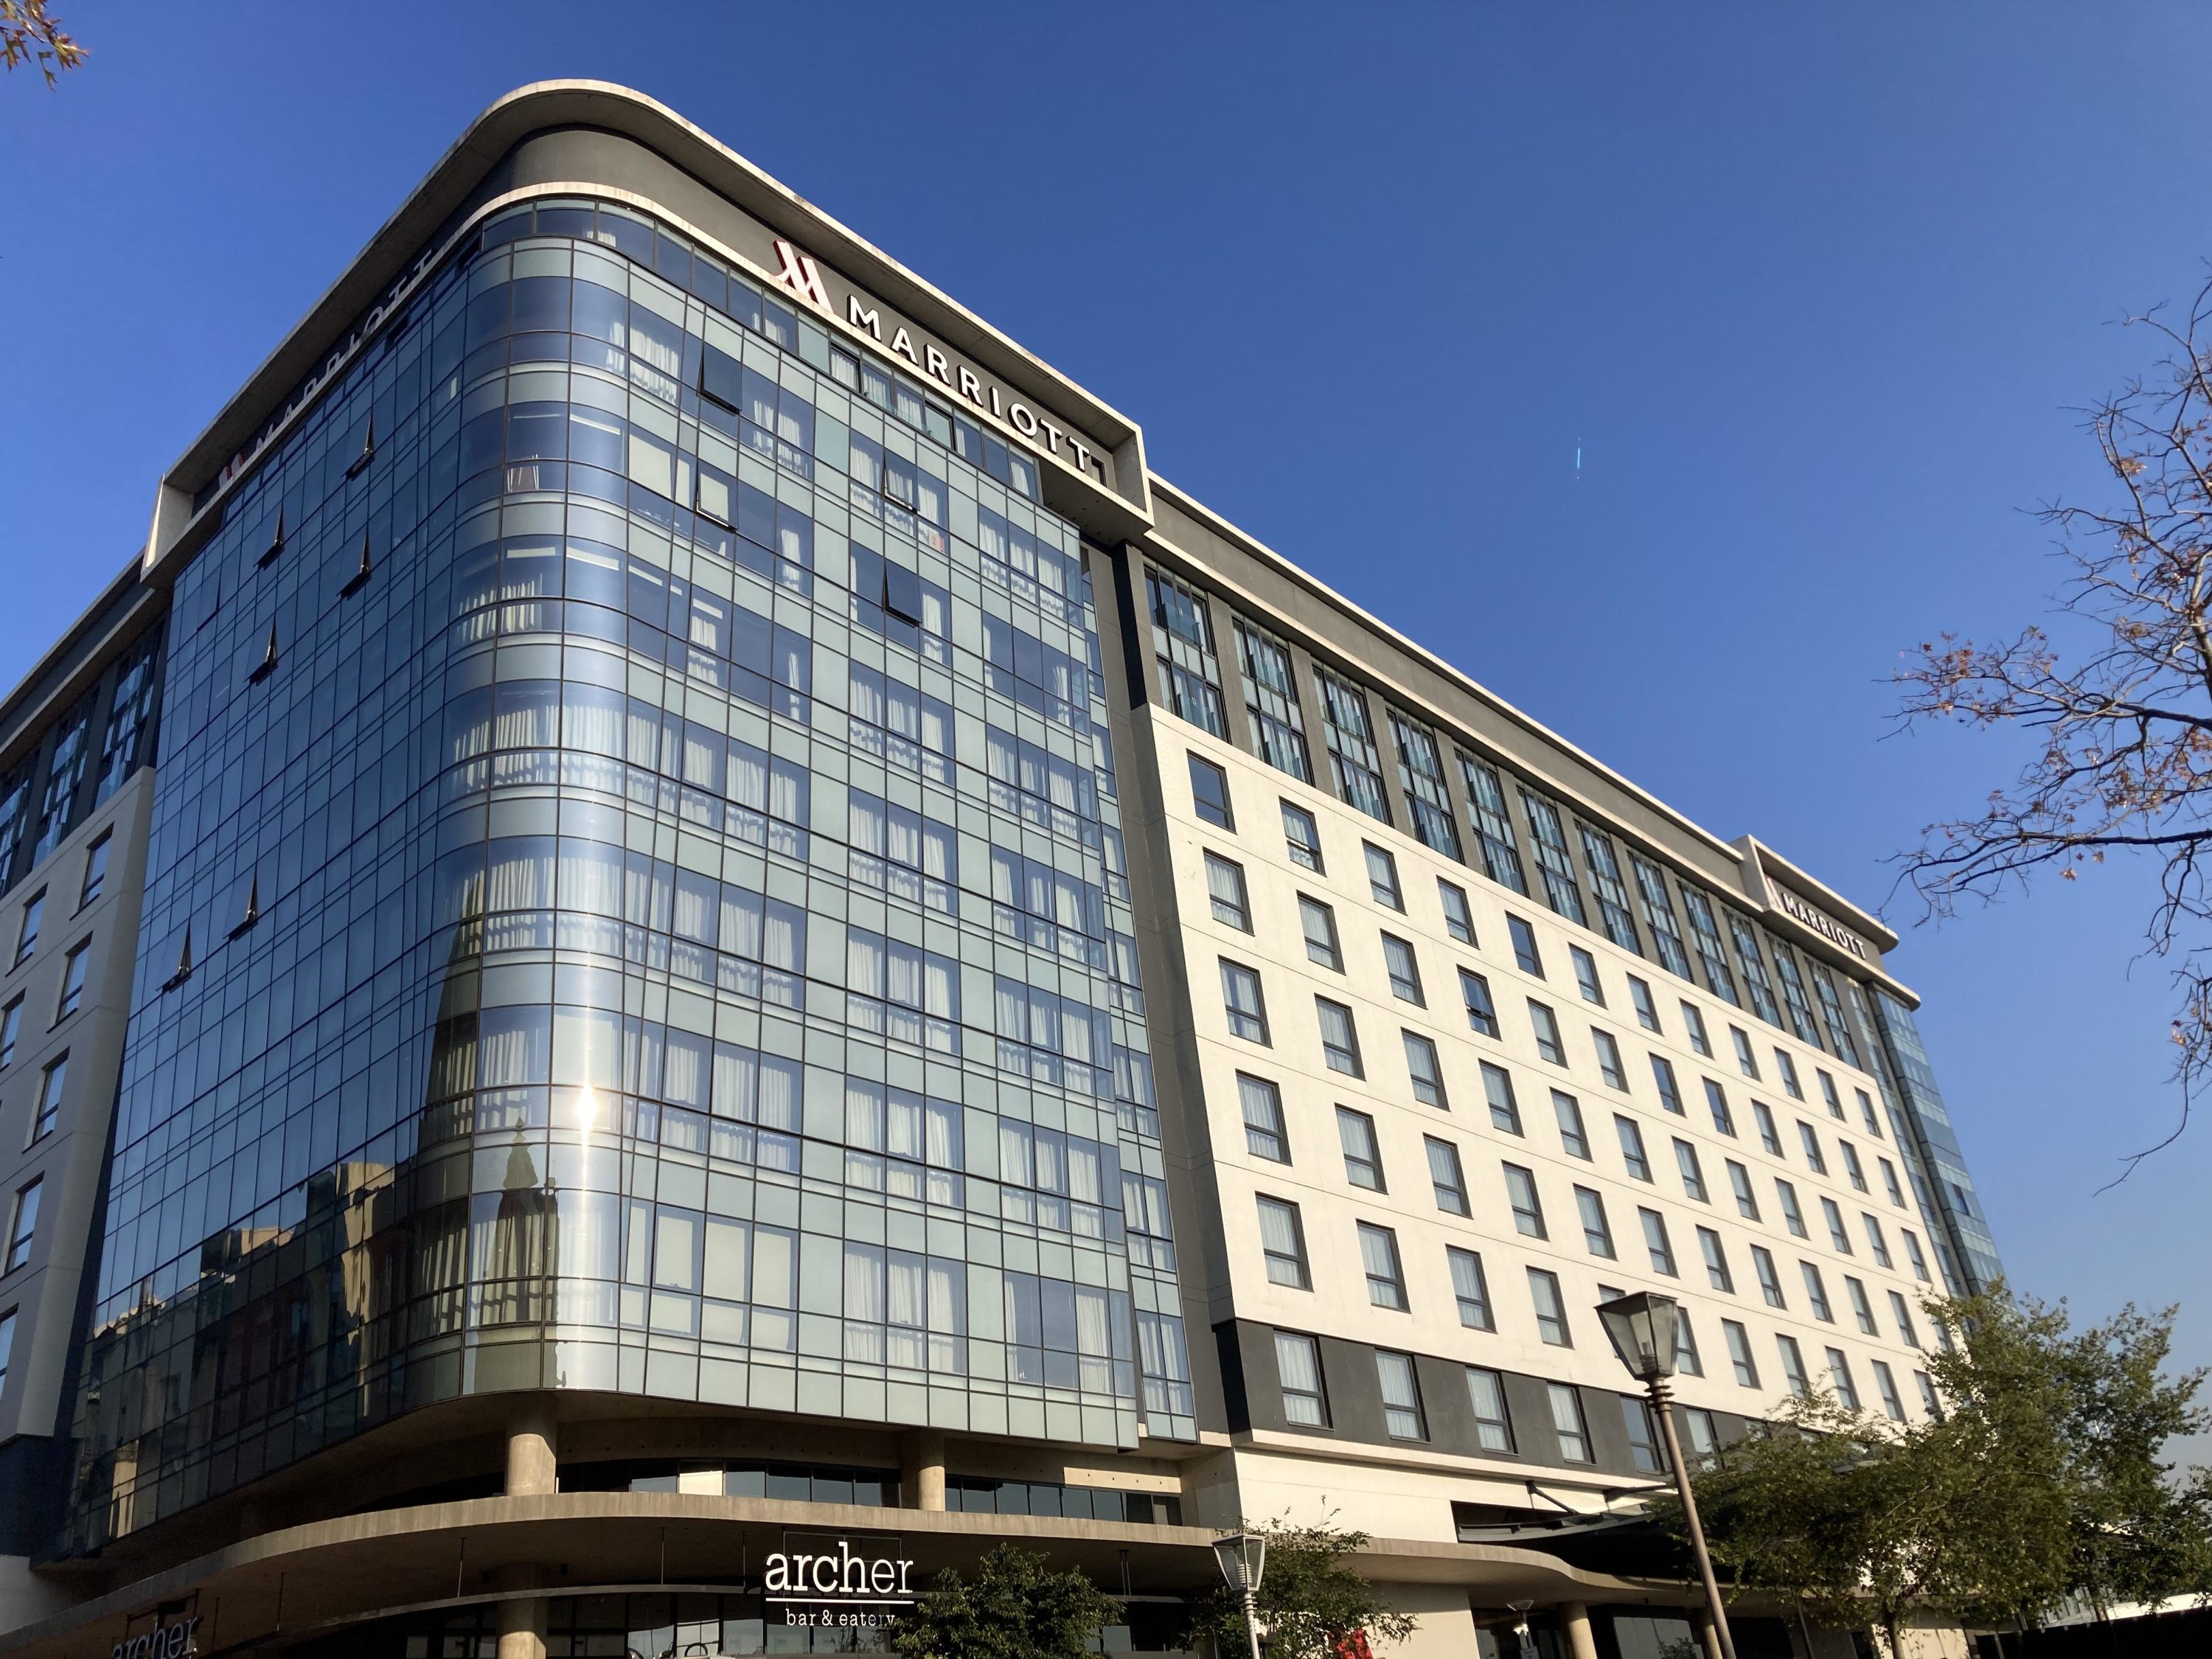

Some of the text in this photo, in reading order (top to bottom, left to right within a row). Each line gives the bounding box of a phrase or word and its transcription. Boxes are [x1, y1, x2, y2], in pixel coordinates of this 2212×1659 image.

[848, 294, 1091, 472] MARRIOTT
[1782, 893, 1866, 959] MARRIOTT
[765, 1542, 914, 1594] archer
[785, 1608, 814, 1626] bar
[821, 1610, 833, 1627] &
